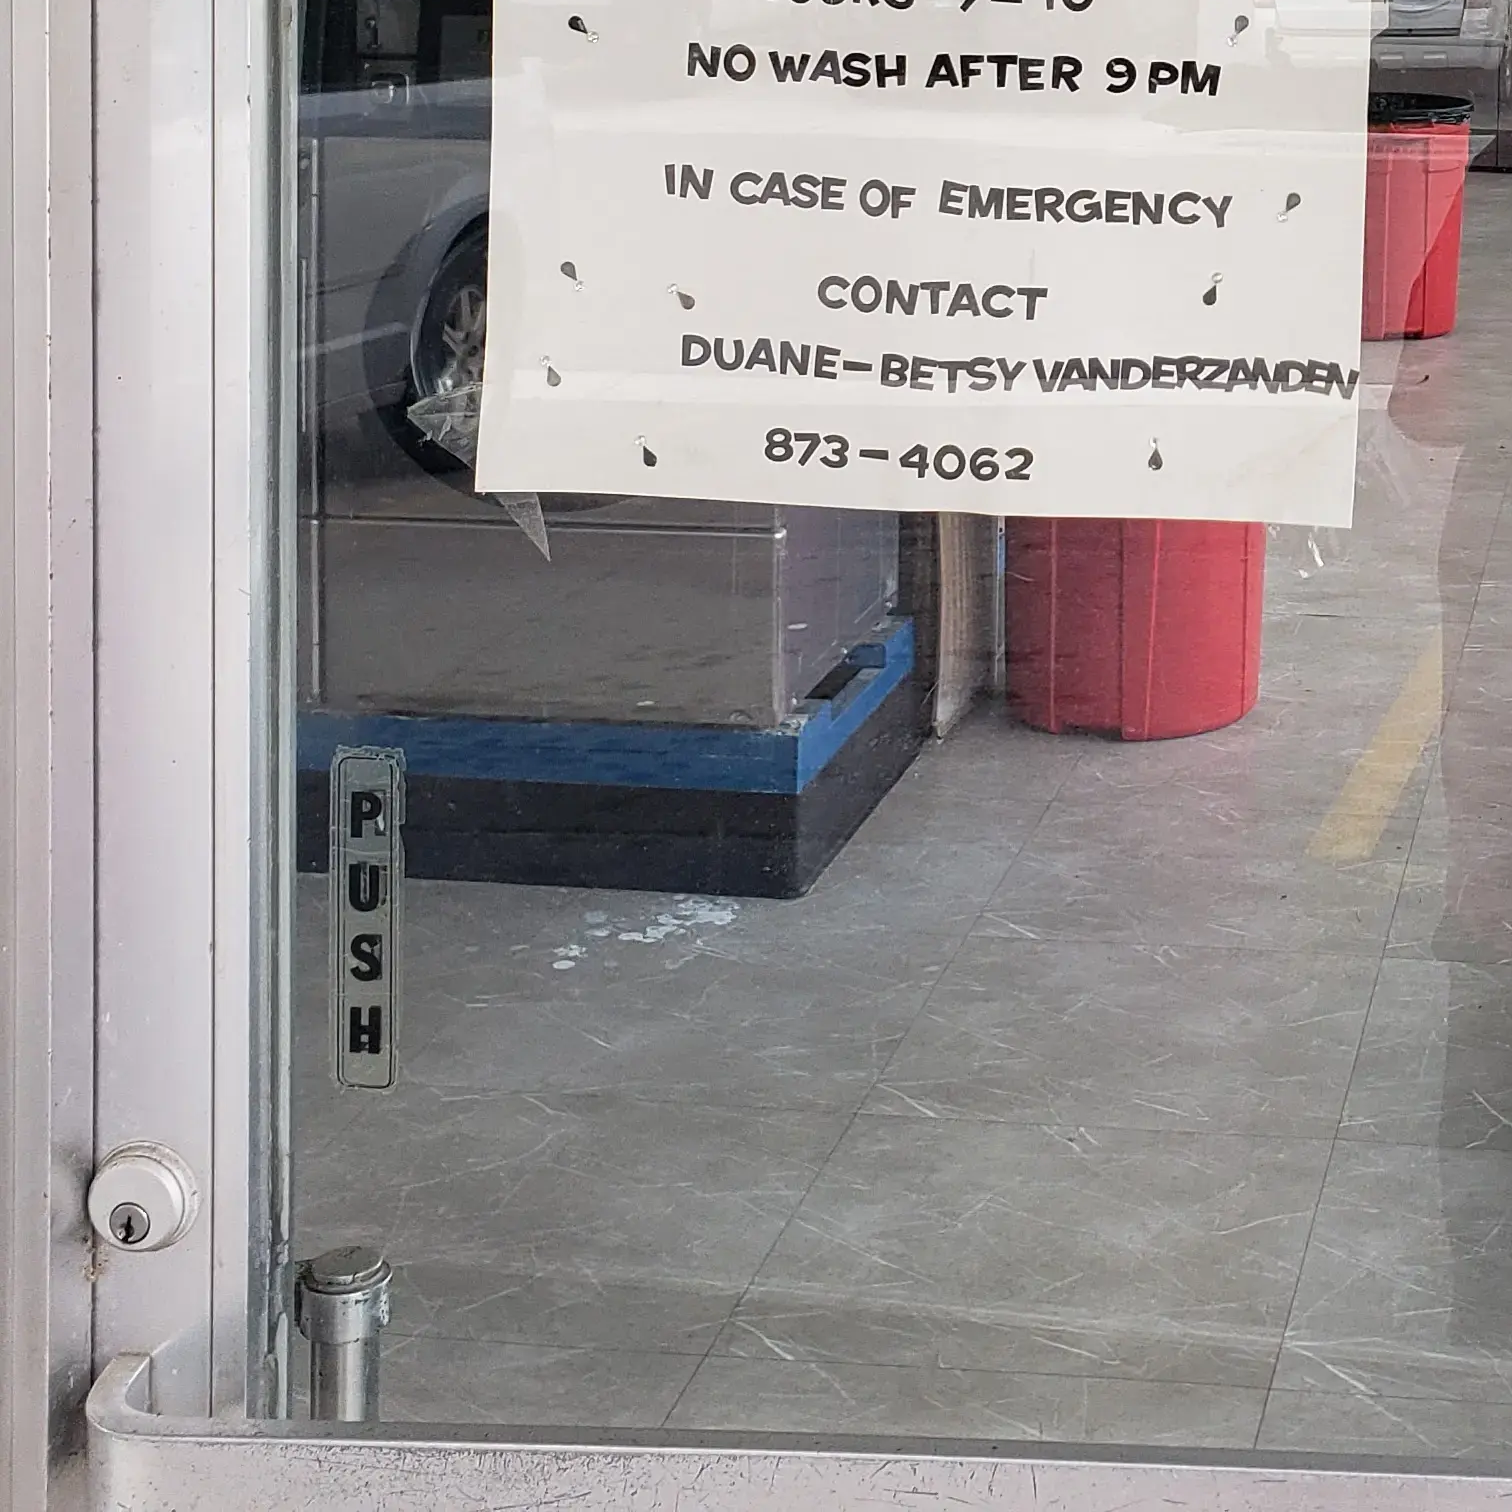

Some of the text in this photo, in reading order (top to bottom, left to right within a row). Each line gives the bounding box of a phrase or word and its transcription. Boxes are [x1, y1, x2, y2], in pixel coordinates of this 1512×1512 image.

[688, 43, 1221, 96] NO WASH AFTER 9 PM
[665, 164, 1232, 228] IN CASE OF EMERGENCY
[818, 276, 1048, 320] CONTACT
[1033, 356, 1360, 400] VANDERZANDEN
[765, 428, 1033, 481] 873-4062
[348, 790, 383, 1055] PUSH
